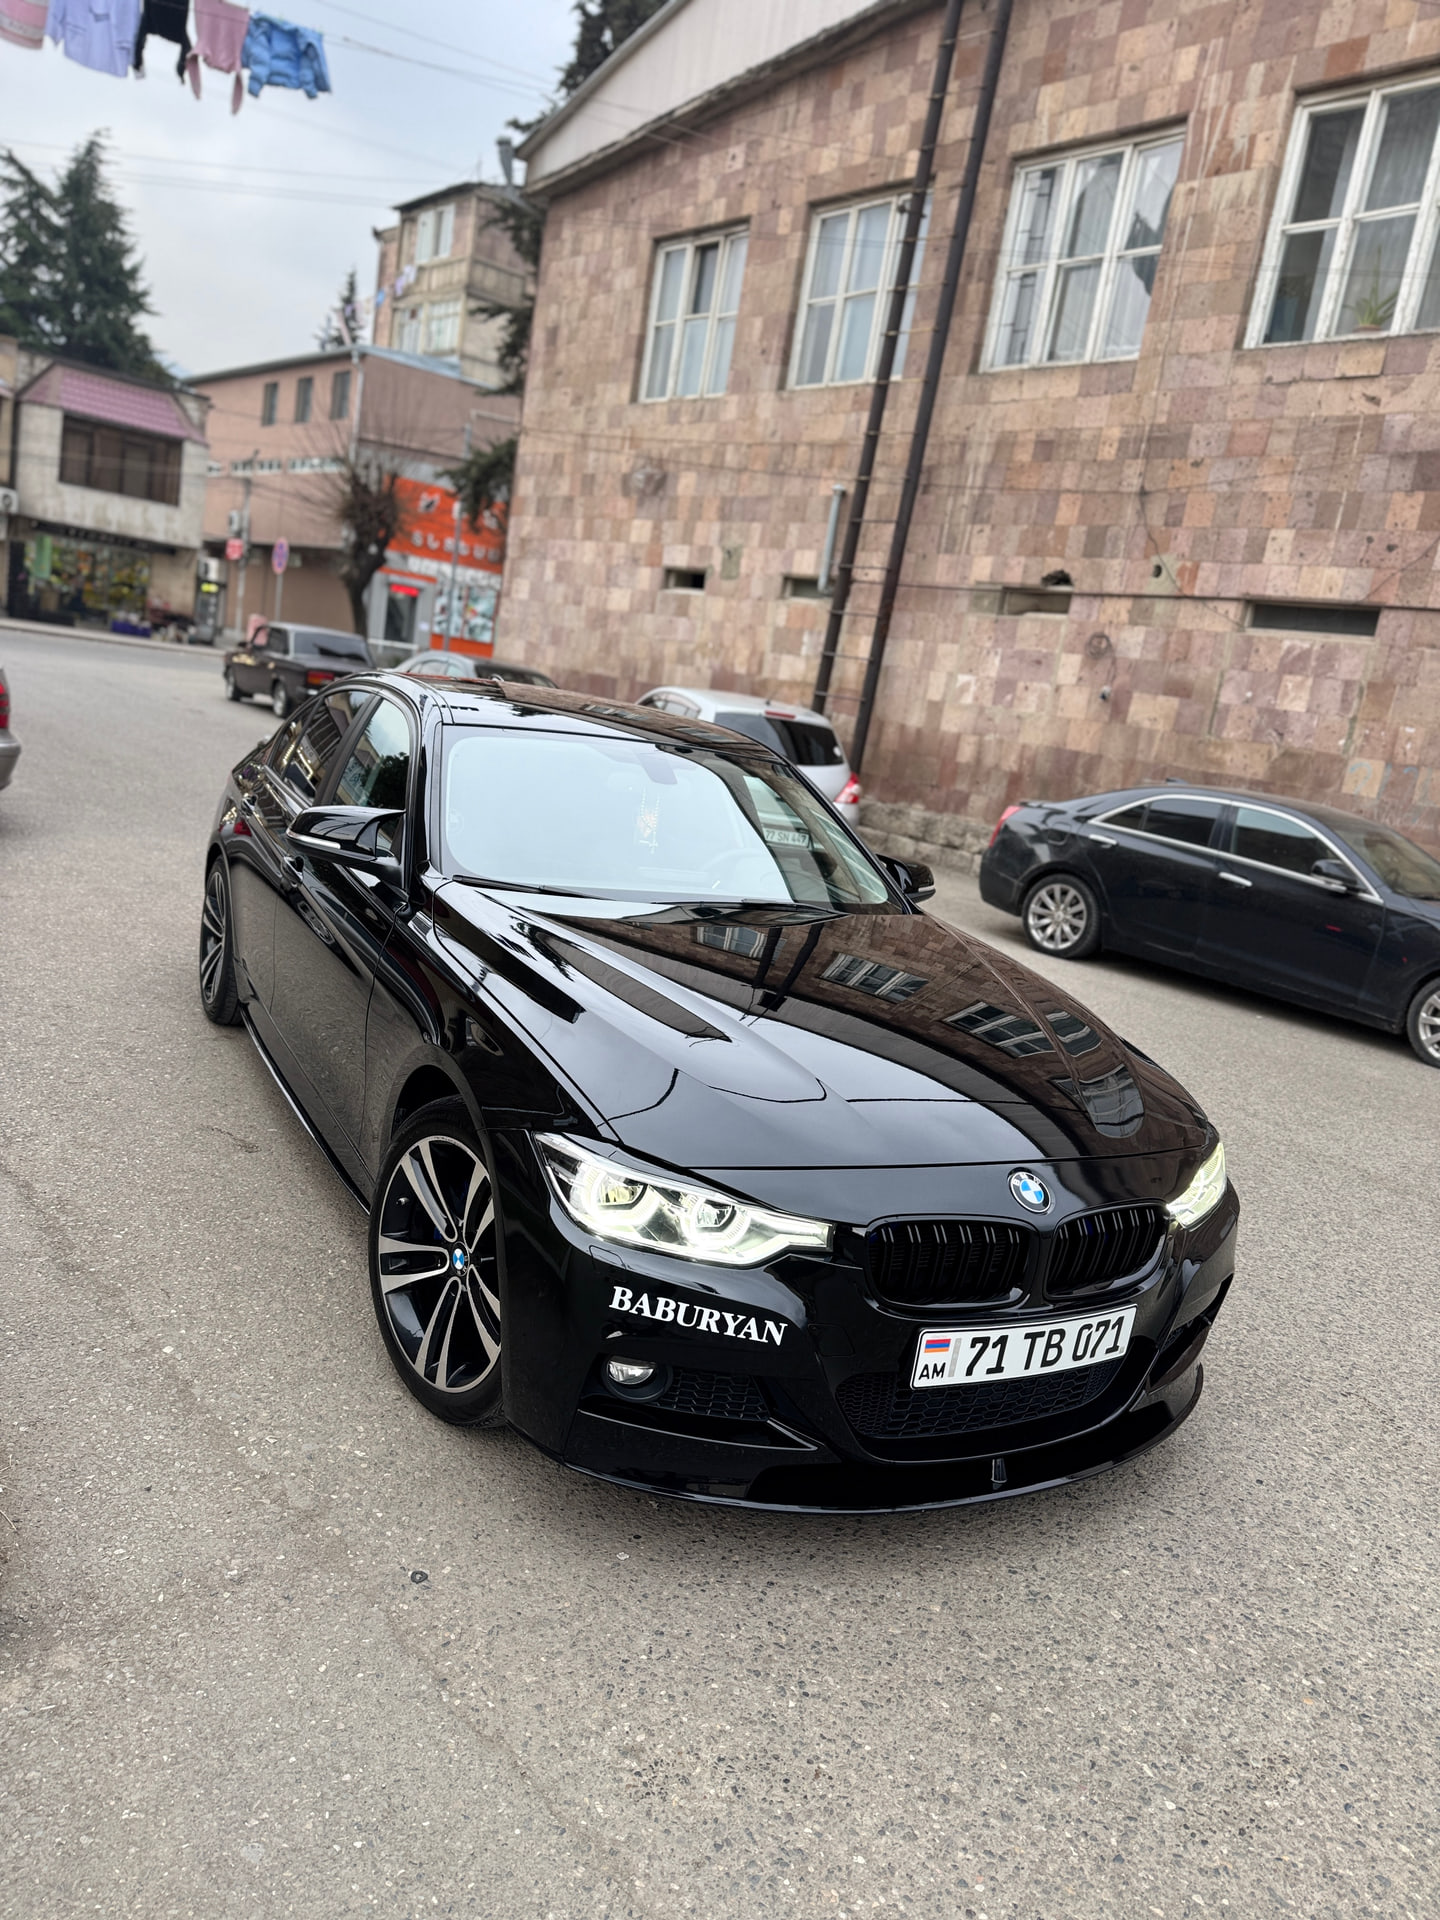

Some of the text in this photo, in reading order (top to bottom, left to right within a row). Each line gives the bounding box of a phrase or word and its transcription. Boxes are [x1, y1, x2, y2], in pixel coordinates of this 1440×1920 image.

[608, 1285, 788, 1346] BABURYAN
[965, 1315, 1124, 1376] 71 TB 071
[918, 1362, 946, 1380] AM
